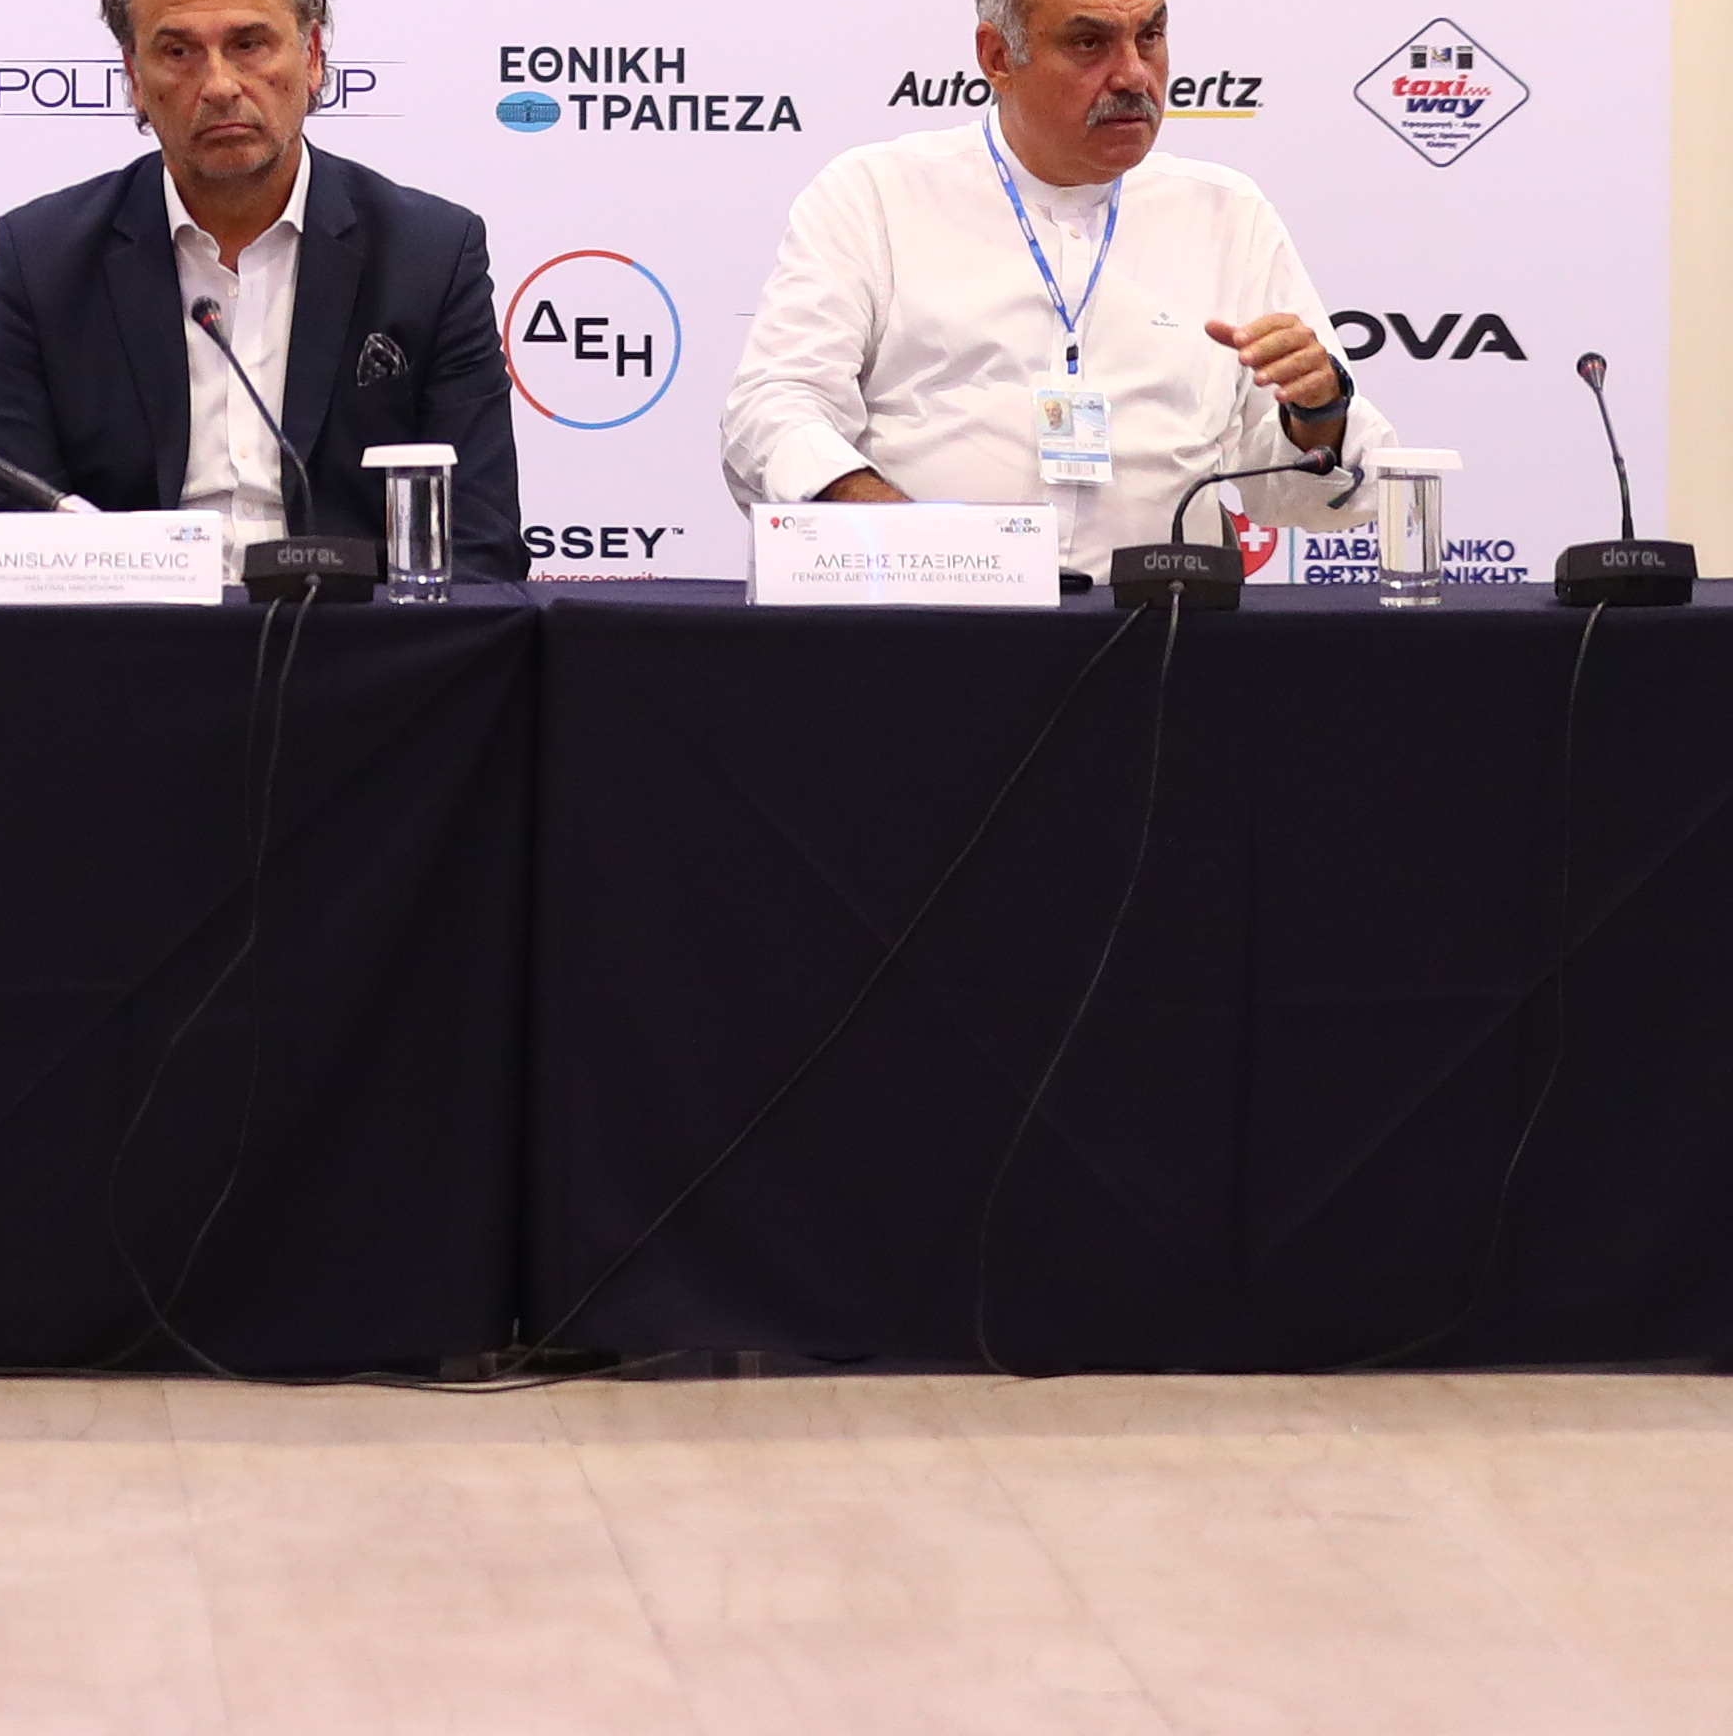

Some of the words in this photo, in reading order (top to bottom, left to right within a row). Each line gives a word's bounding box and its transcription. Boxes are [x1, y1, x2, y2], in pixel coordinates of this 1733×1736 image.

[500, 46, 685, 84] ΕΘΝΙΚΗ
[1391, 73, 1469, 97] taxi
[568, 94, 802, 132] ΤΡΑΠΕΖΑ
[1406, 98, 1485, 119] way
[522, 300, 652, 378] ΔΕΗ
[814, 553, 890, 569] ΑΛΕΞΗΣ
